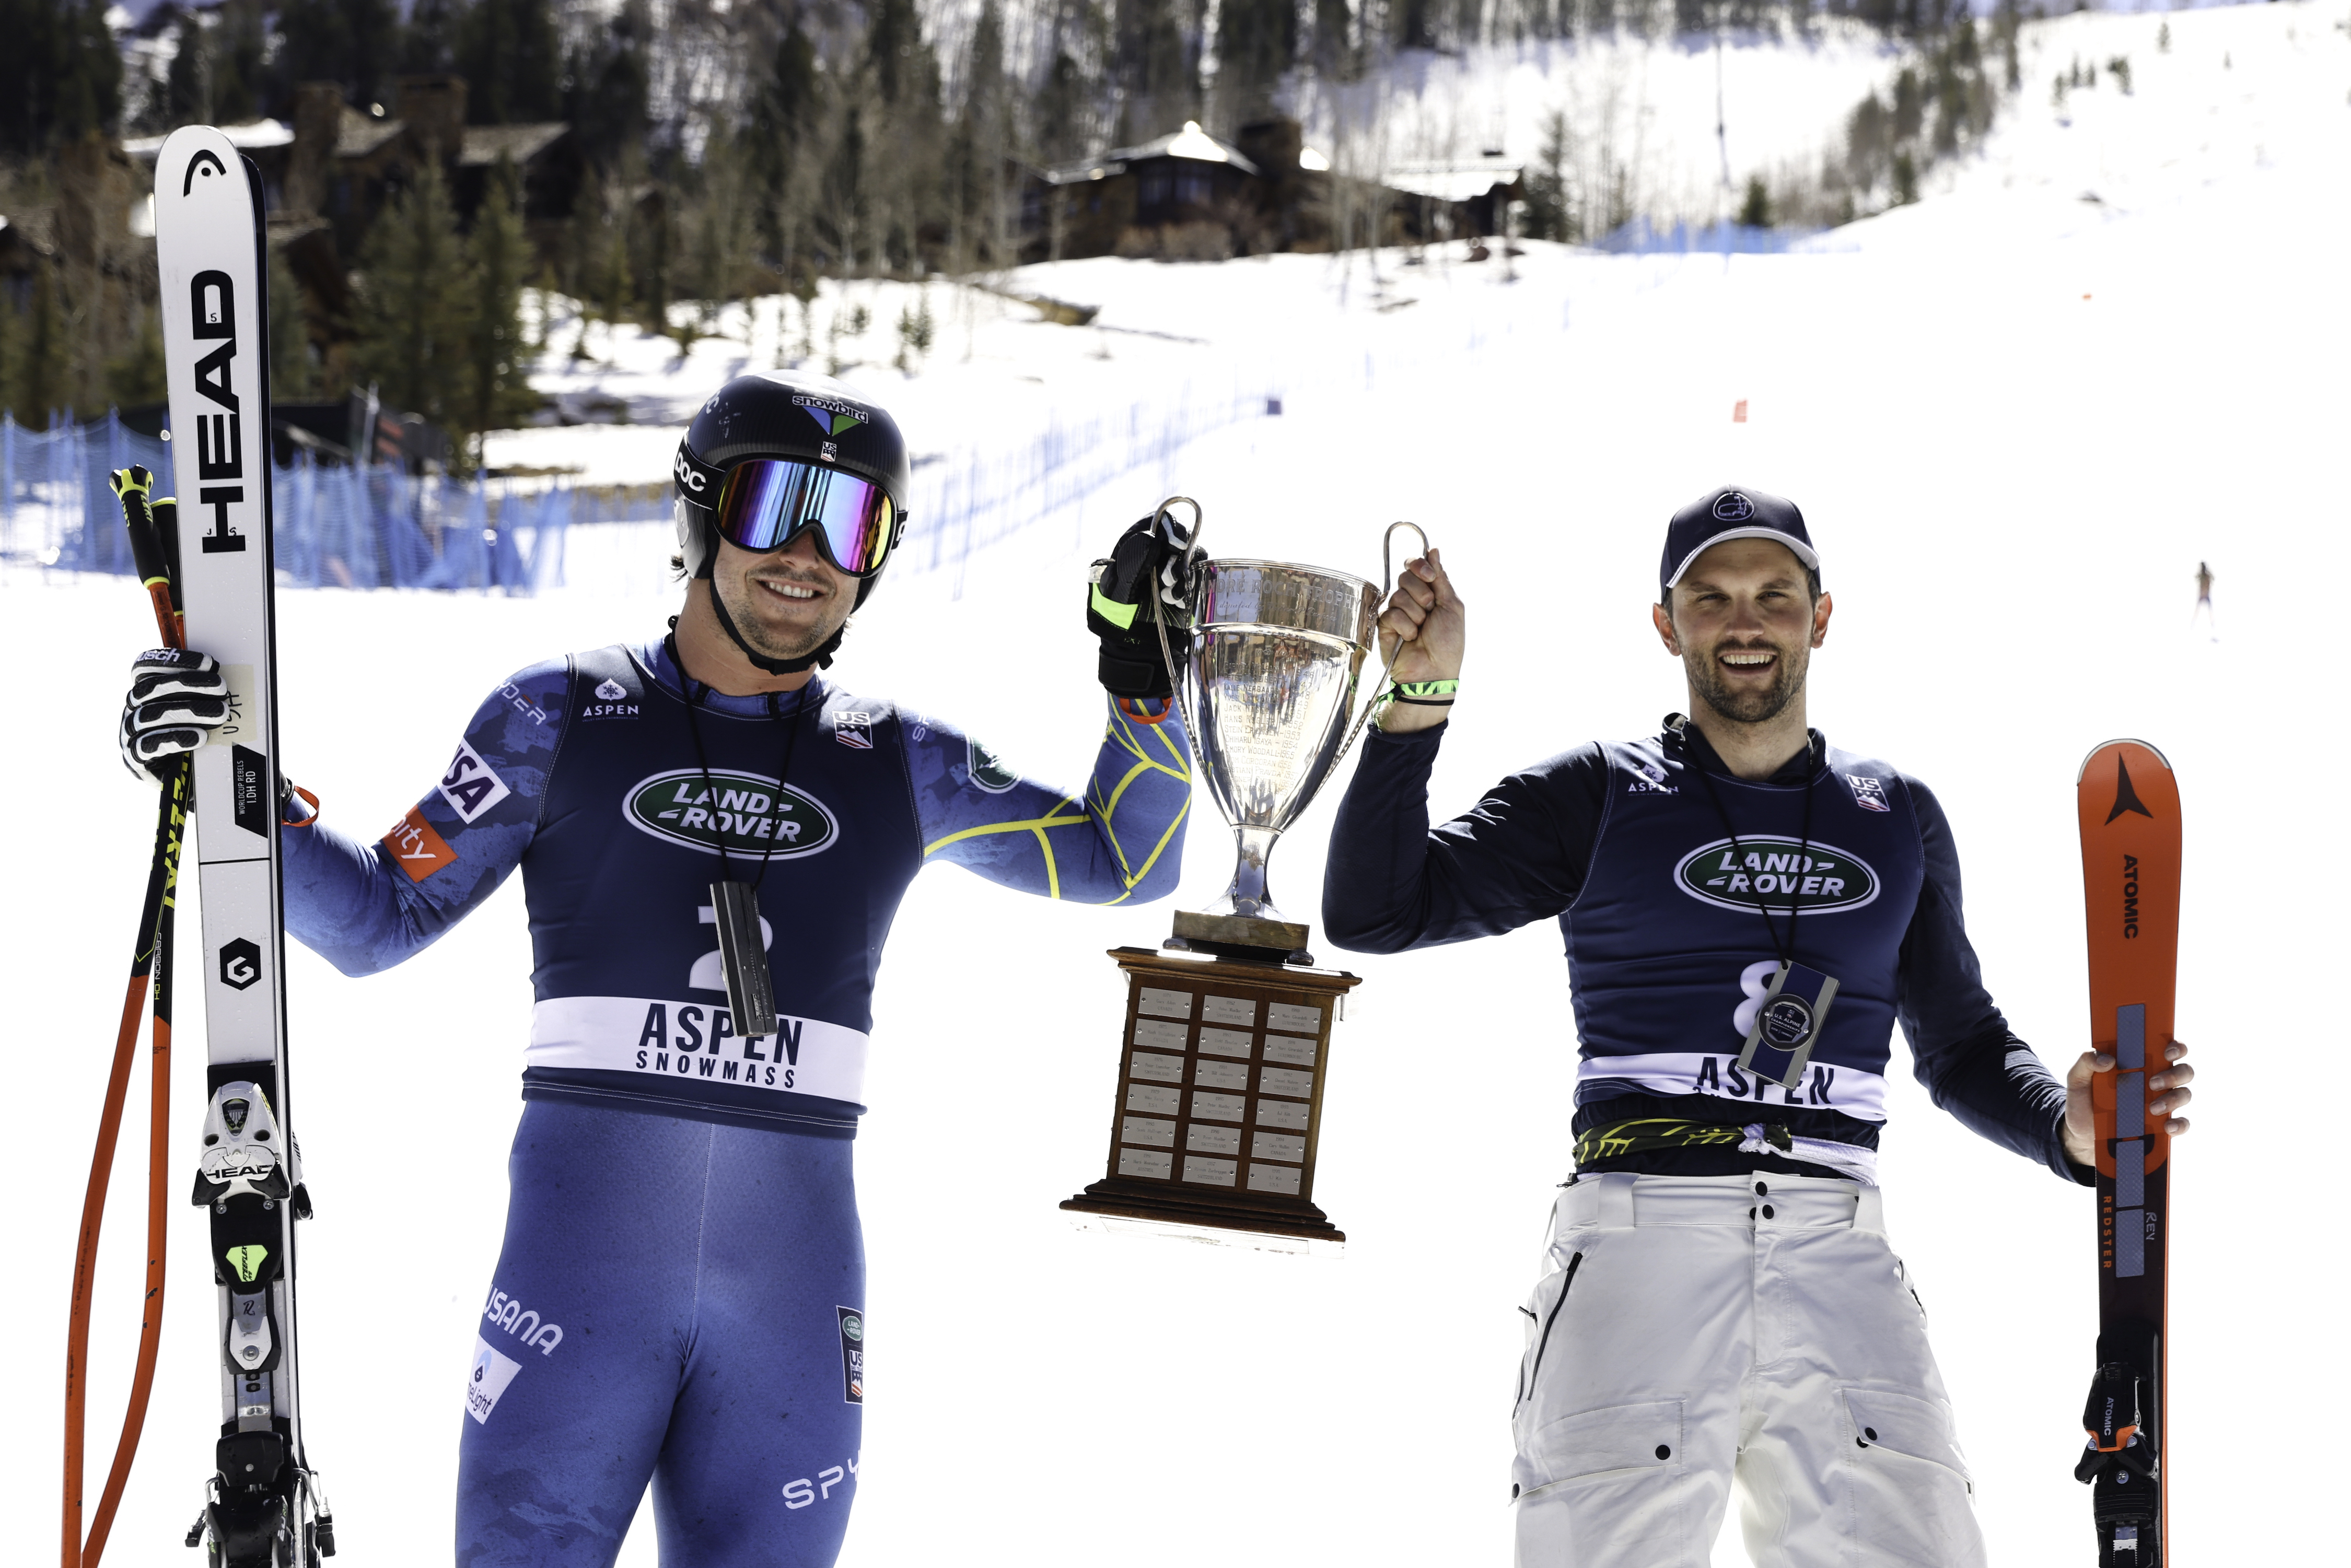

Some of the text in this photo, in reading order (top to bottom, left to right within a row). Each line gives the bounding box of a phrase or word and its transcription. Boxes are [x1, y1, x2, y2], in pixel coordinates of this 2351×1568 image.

[191, 270, 246, 553] HEAD
[794, 397, 867, 423] snowbird
[1251, 579, 1297, 598] ROCH
[1304, 584, 1361, 610] TROPHY
[135, 648, 181, 665] usch
[583, 705, 639, 717] ASPEN
[834, 711, 869, 724] US
[1224, 703, 1241, 712] JACK
[1224, 714, 1242, 723] HANS
[1224, 724, 1242, 733] STEIN
[1225, 734, 1298, 751] CHIHARU IGAYA 1954
[1278, 760, 1293, 770] 1956
[237, 760, 246, 815] WORLDCUP REBELS
[246, 771, 256, 783] RD
[442, 748, 495, 815] SA
[1627, 782, 1679, 793] ASPEN
[1846, 774, 1881, 790] US
[672, 783, 771, 815] LAND
[680, 807, 801, 843] ROVER
[1718, 852, 1813, 873] LAND
[1727, 874, 1845, 897] ROVER
[2124, 853, 2138, 940] ATOMIC
[154, 984, 161, 1000] DH
[1771, 1017, 1800, 1033] CHAMPIONSHIPS
[1783, 1017, 1801, 1027] ALPINE
[635, 1050, 795, 1089] SNOWMASS
[2103, 1196, 2112, 1269] REDSTER
[2146, 1211, 2157, 1241] REV
[483, 1283, 564, 1356] USANA
[850, 1351, 862, 1367] US
[2103, 1397, 2114, 1437] ATOMIC
[783, 1449, 860, 1510] SPY
